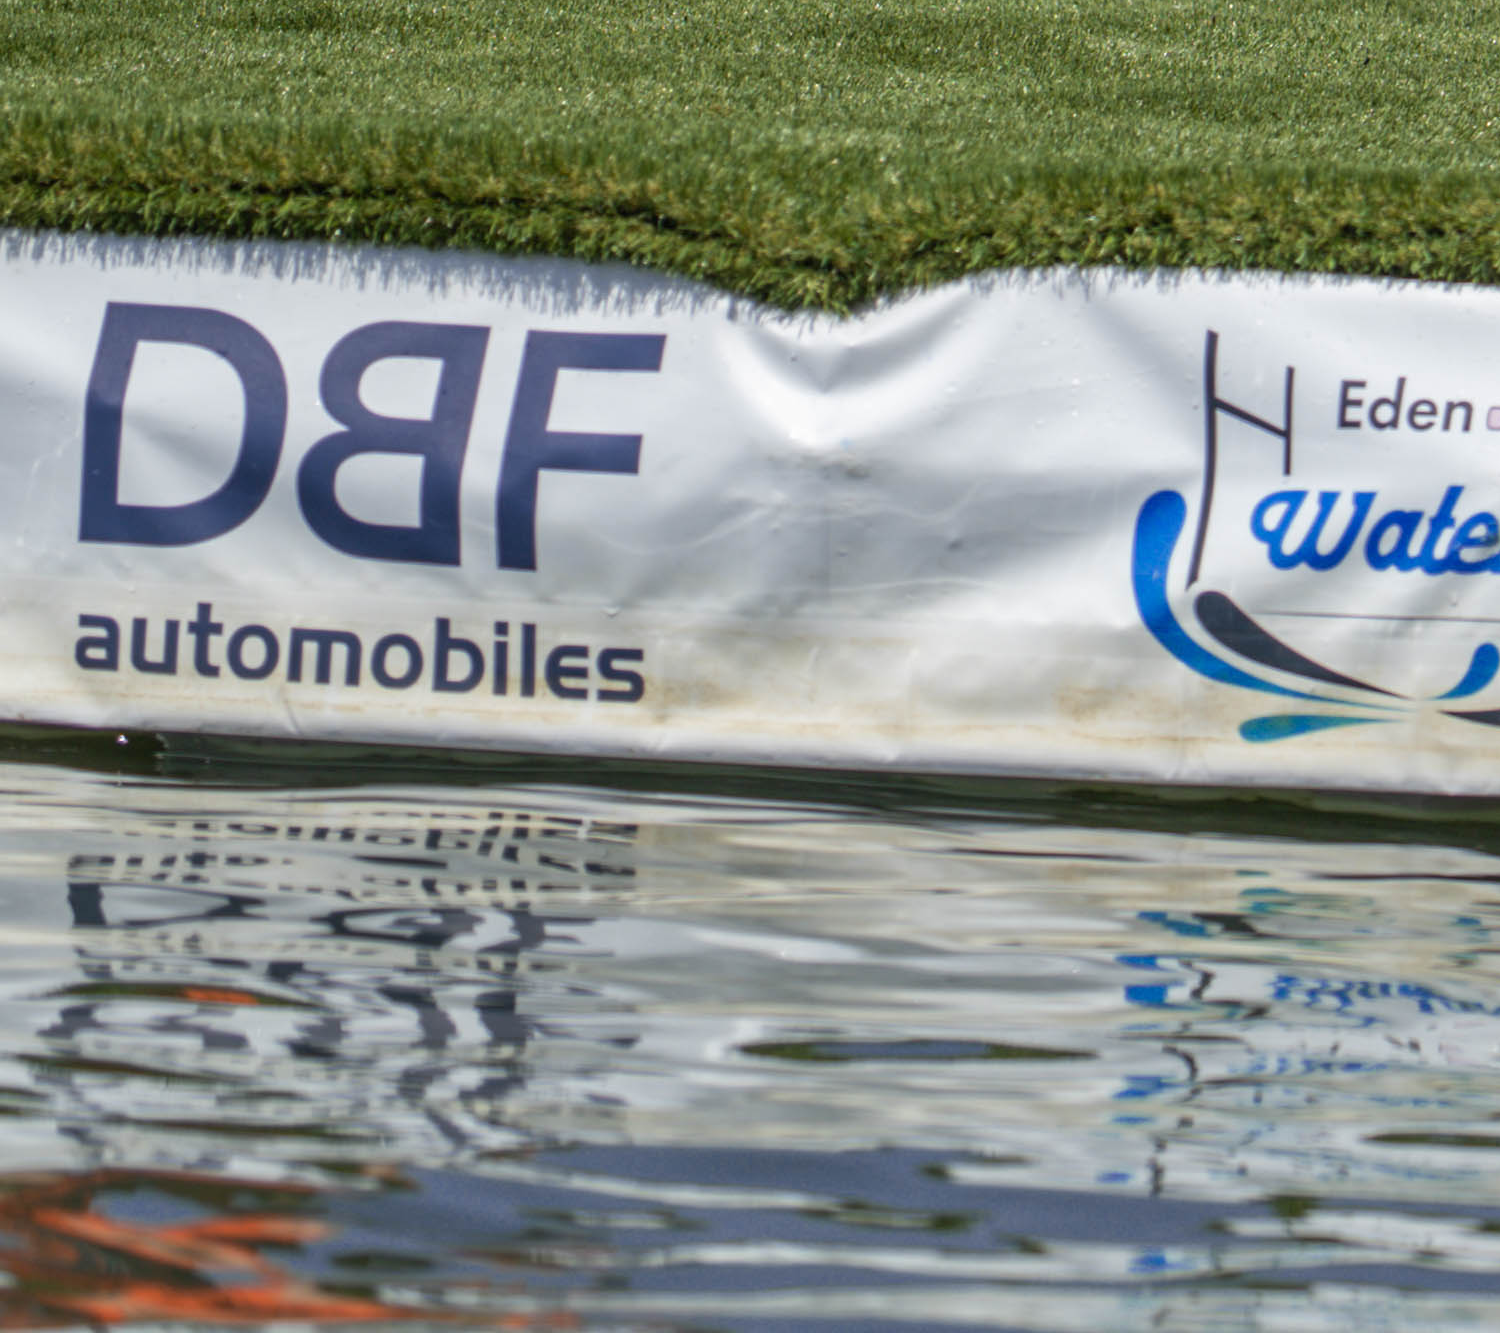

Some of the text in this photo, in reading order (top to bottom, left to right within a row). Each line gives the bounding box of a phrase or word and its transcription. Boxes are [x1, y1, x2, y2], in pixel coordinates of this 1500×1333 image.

[79, 302, 667, 572] DBF
[1337, 378, 1474, 432] Eden
[74, 602, 646, 703] automobiles
